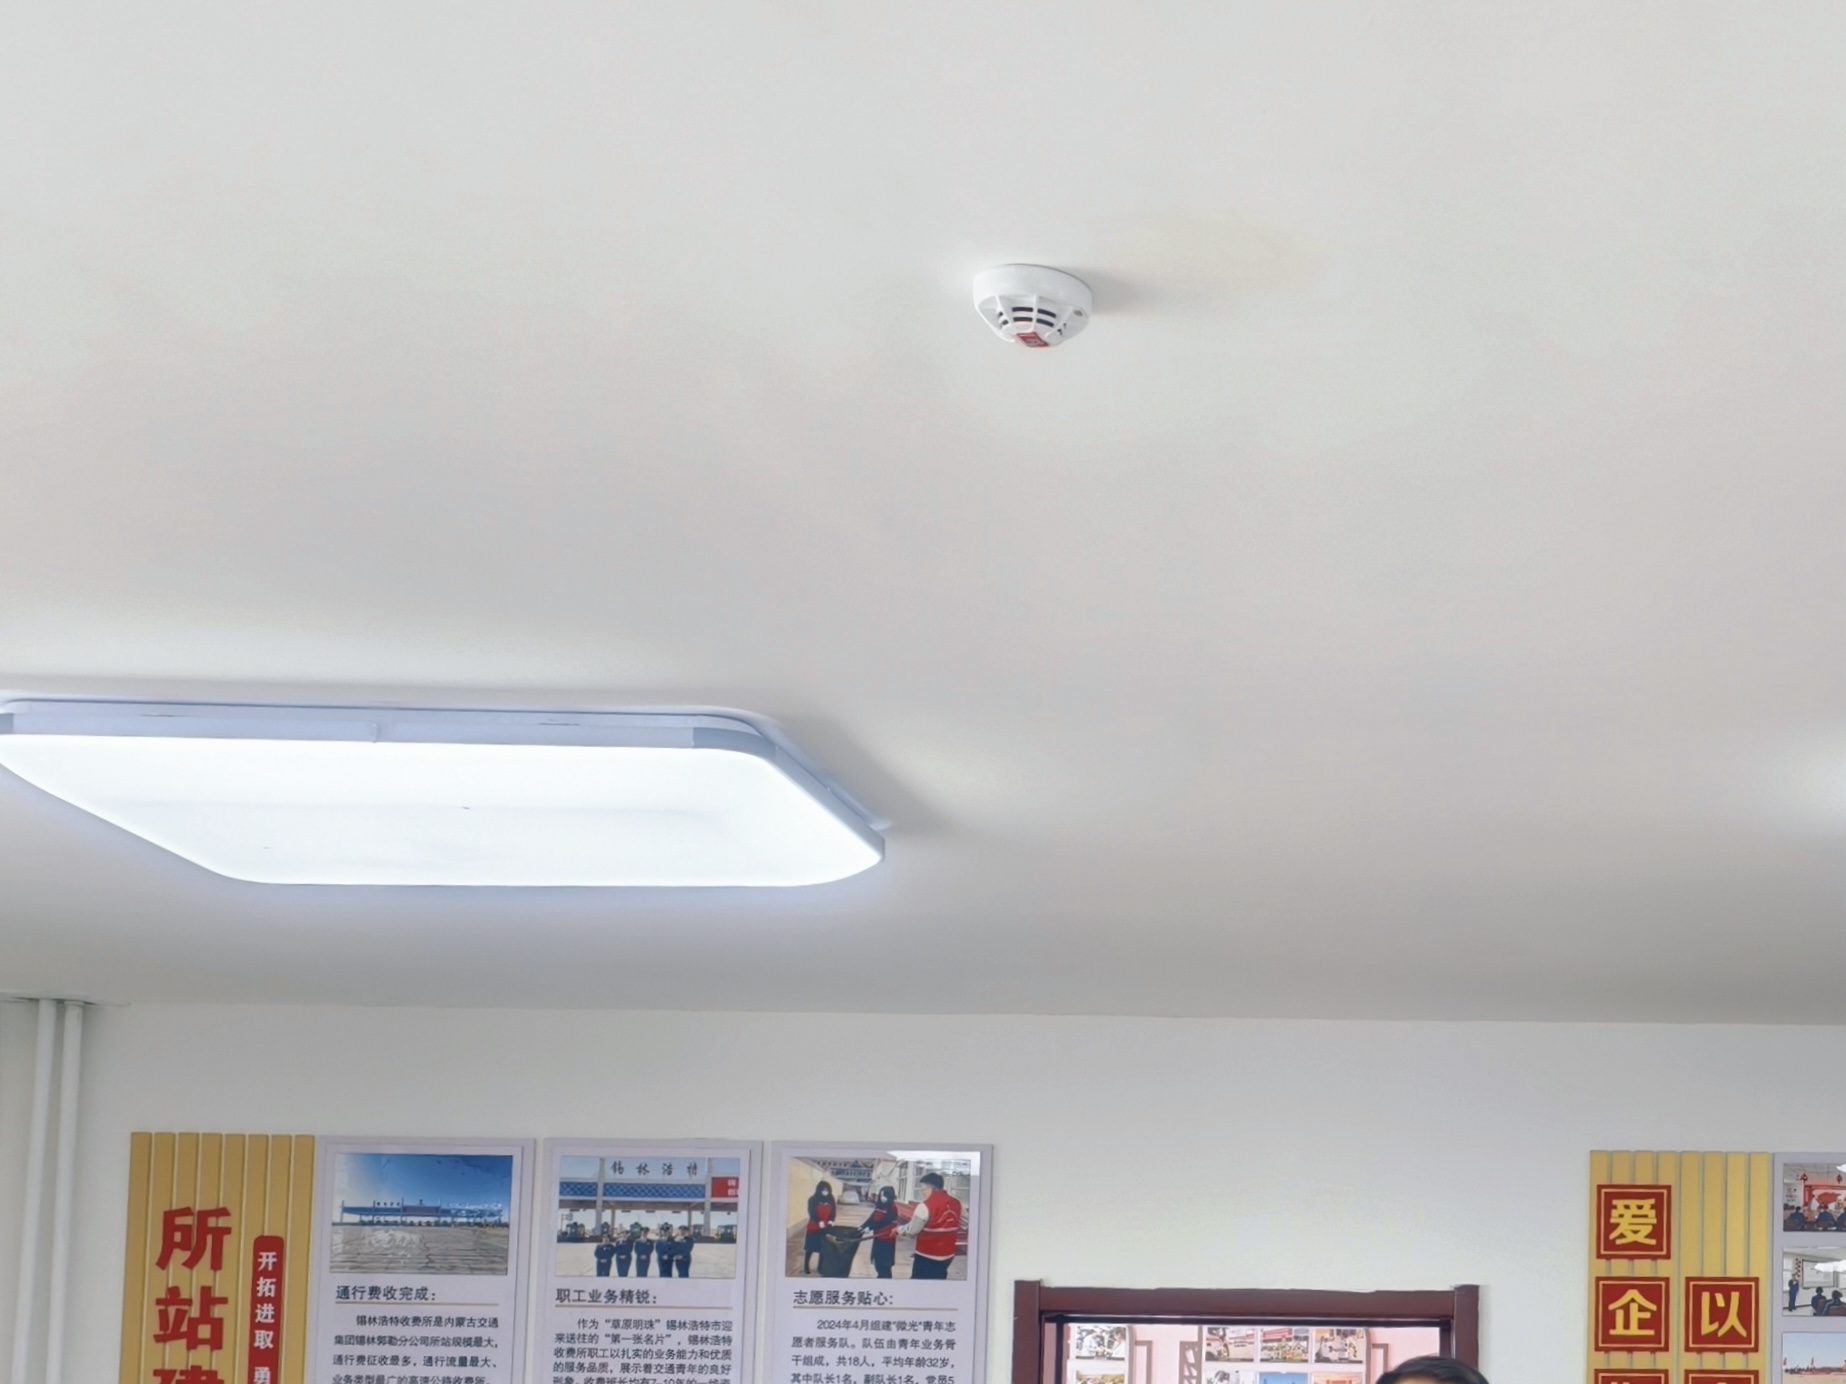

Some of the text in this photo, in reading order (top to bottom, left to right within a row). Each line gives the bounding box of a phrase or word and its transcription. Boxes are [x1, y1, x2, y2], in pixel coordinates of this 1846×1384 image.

[254, 1251, 278, 1349] 开拓进取
[336, 1285, 437, 1301] 通行费收完成：
